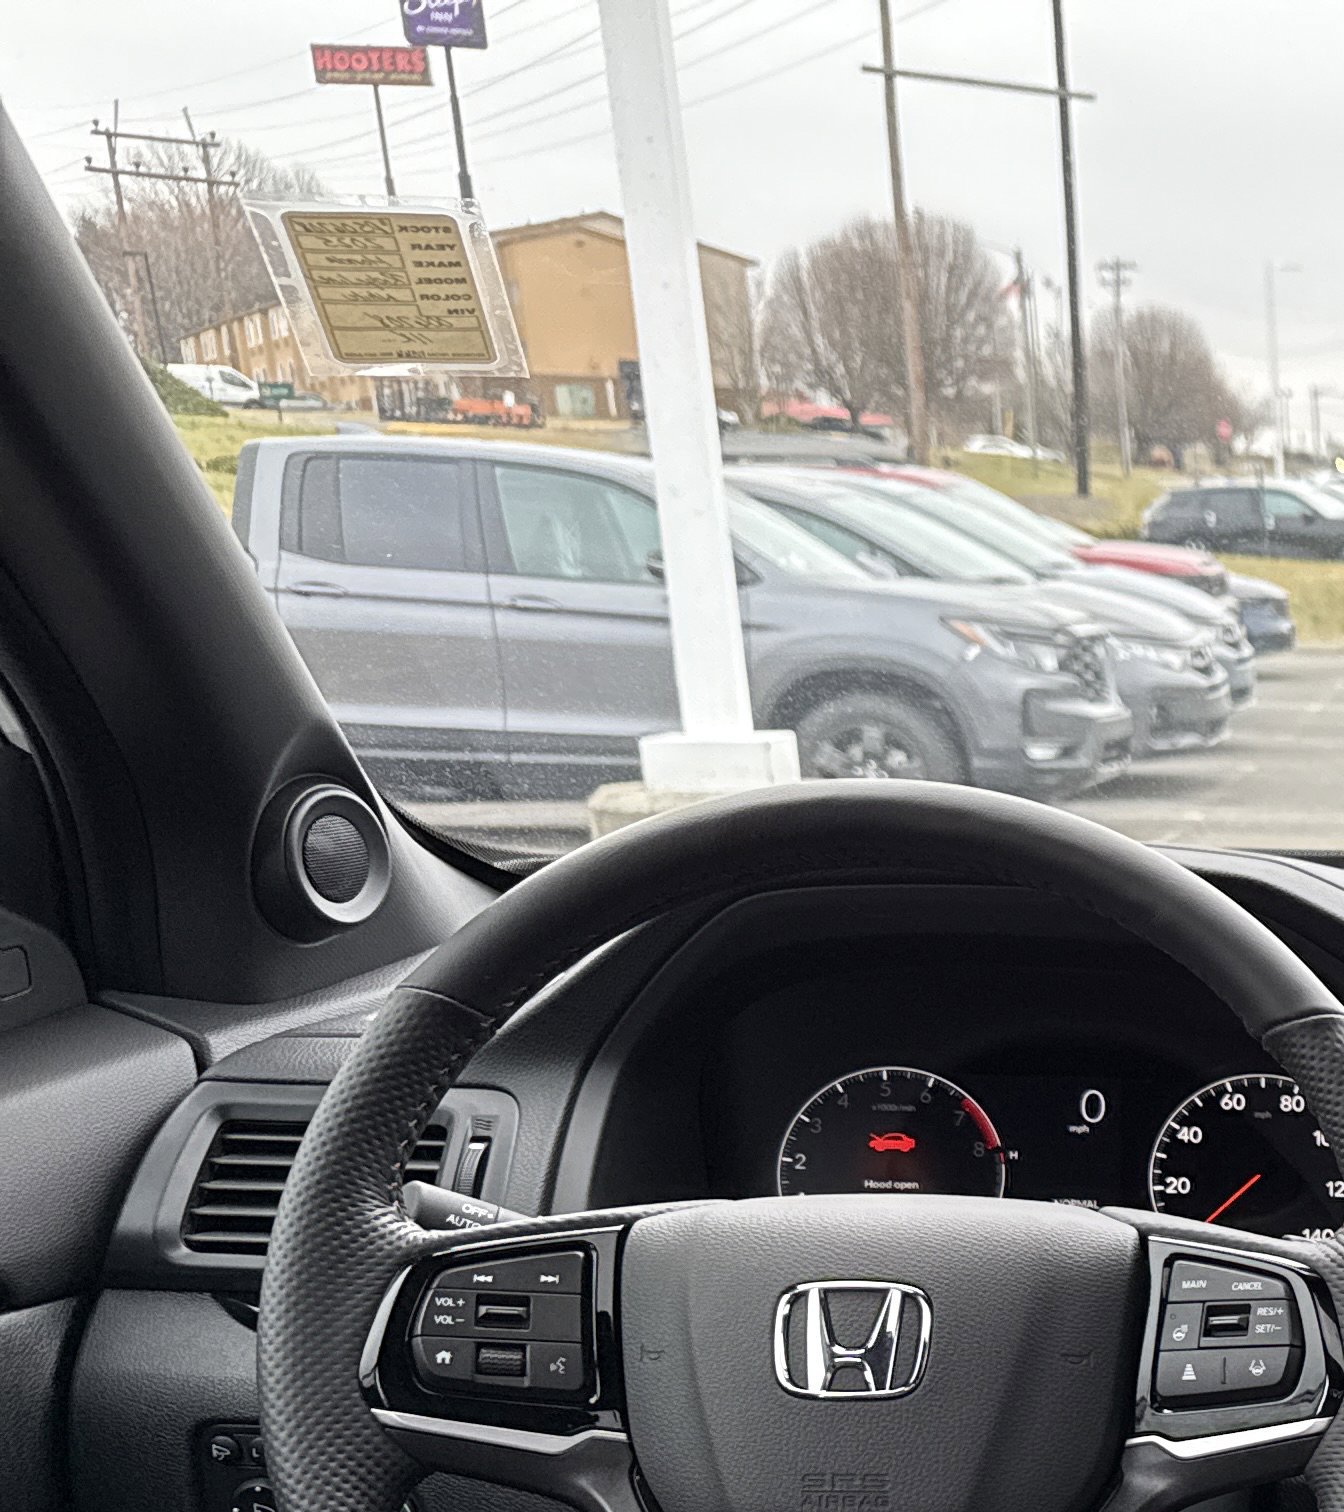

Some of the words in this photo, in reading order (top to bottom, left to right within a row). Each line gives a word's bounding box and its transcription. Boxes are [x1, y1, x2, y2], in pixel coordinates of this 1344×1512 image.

[314, 48, 425, 72] HOOTERS
[1080, 1089, 1106, 1123] 0
[1219, 1093, 1246, 1111] 60
[1279, 1094, 1305, 1112] 80
[1068, 1125, 1090, 1134] mph
[1177, 1127, 1203, 1144] 40
[794, 1153, 807, 1170] 2
[864, 1179, 893, 1189] Hood
[893, 1181, 920, 1191] open
[1165, 1177, 1191, 1195] 20
[462, 1203, 489, 1217] OFF
[1181, 1280, 1207, 1289] MAIN
[1231, 1281, 1263, 1291] CANCEL
